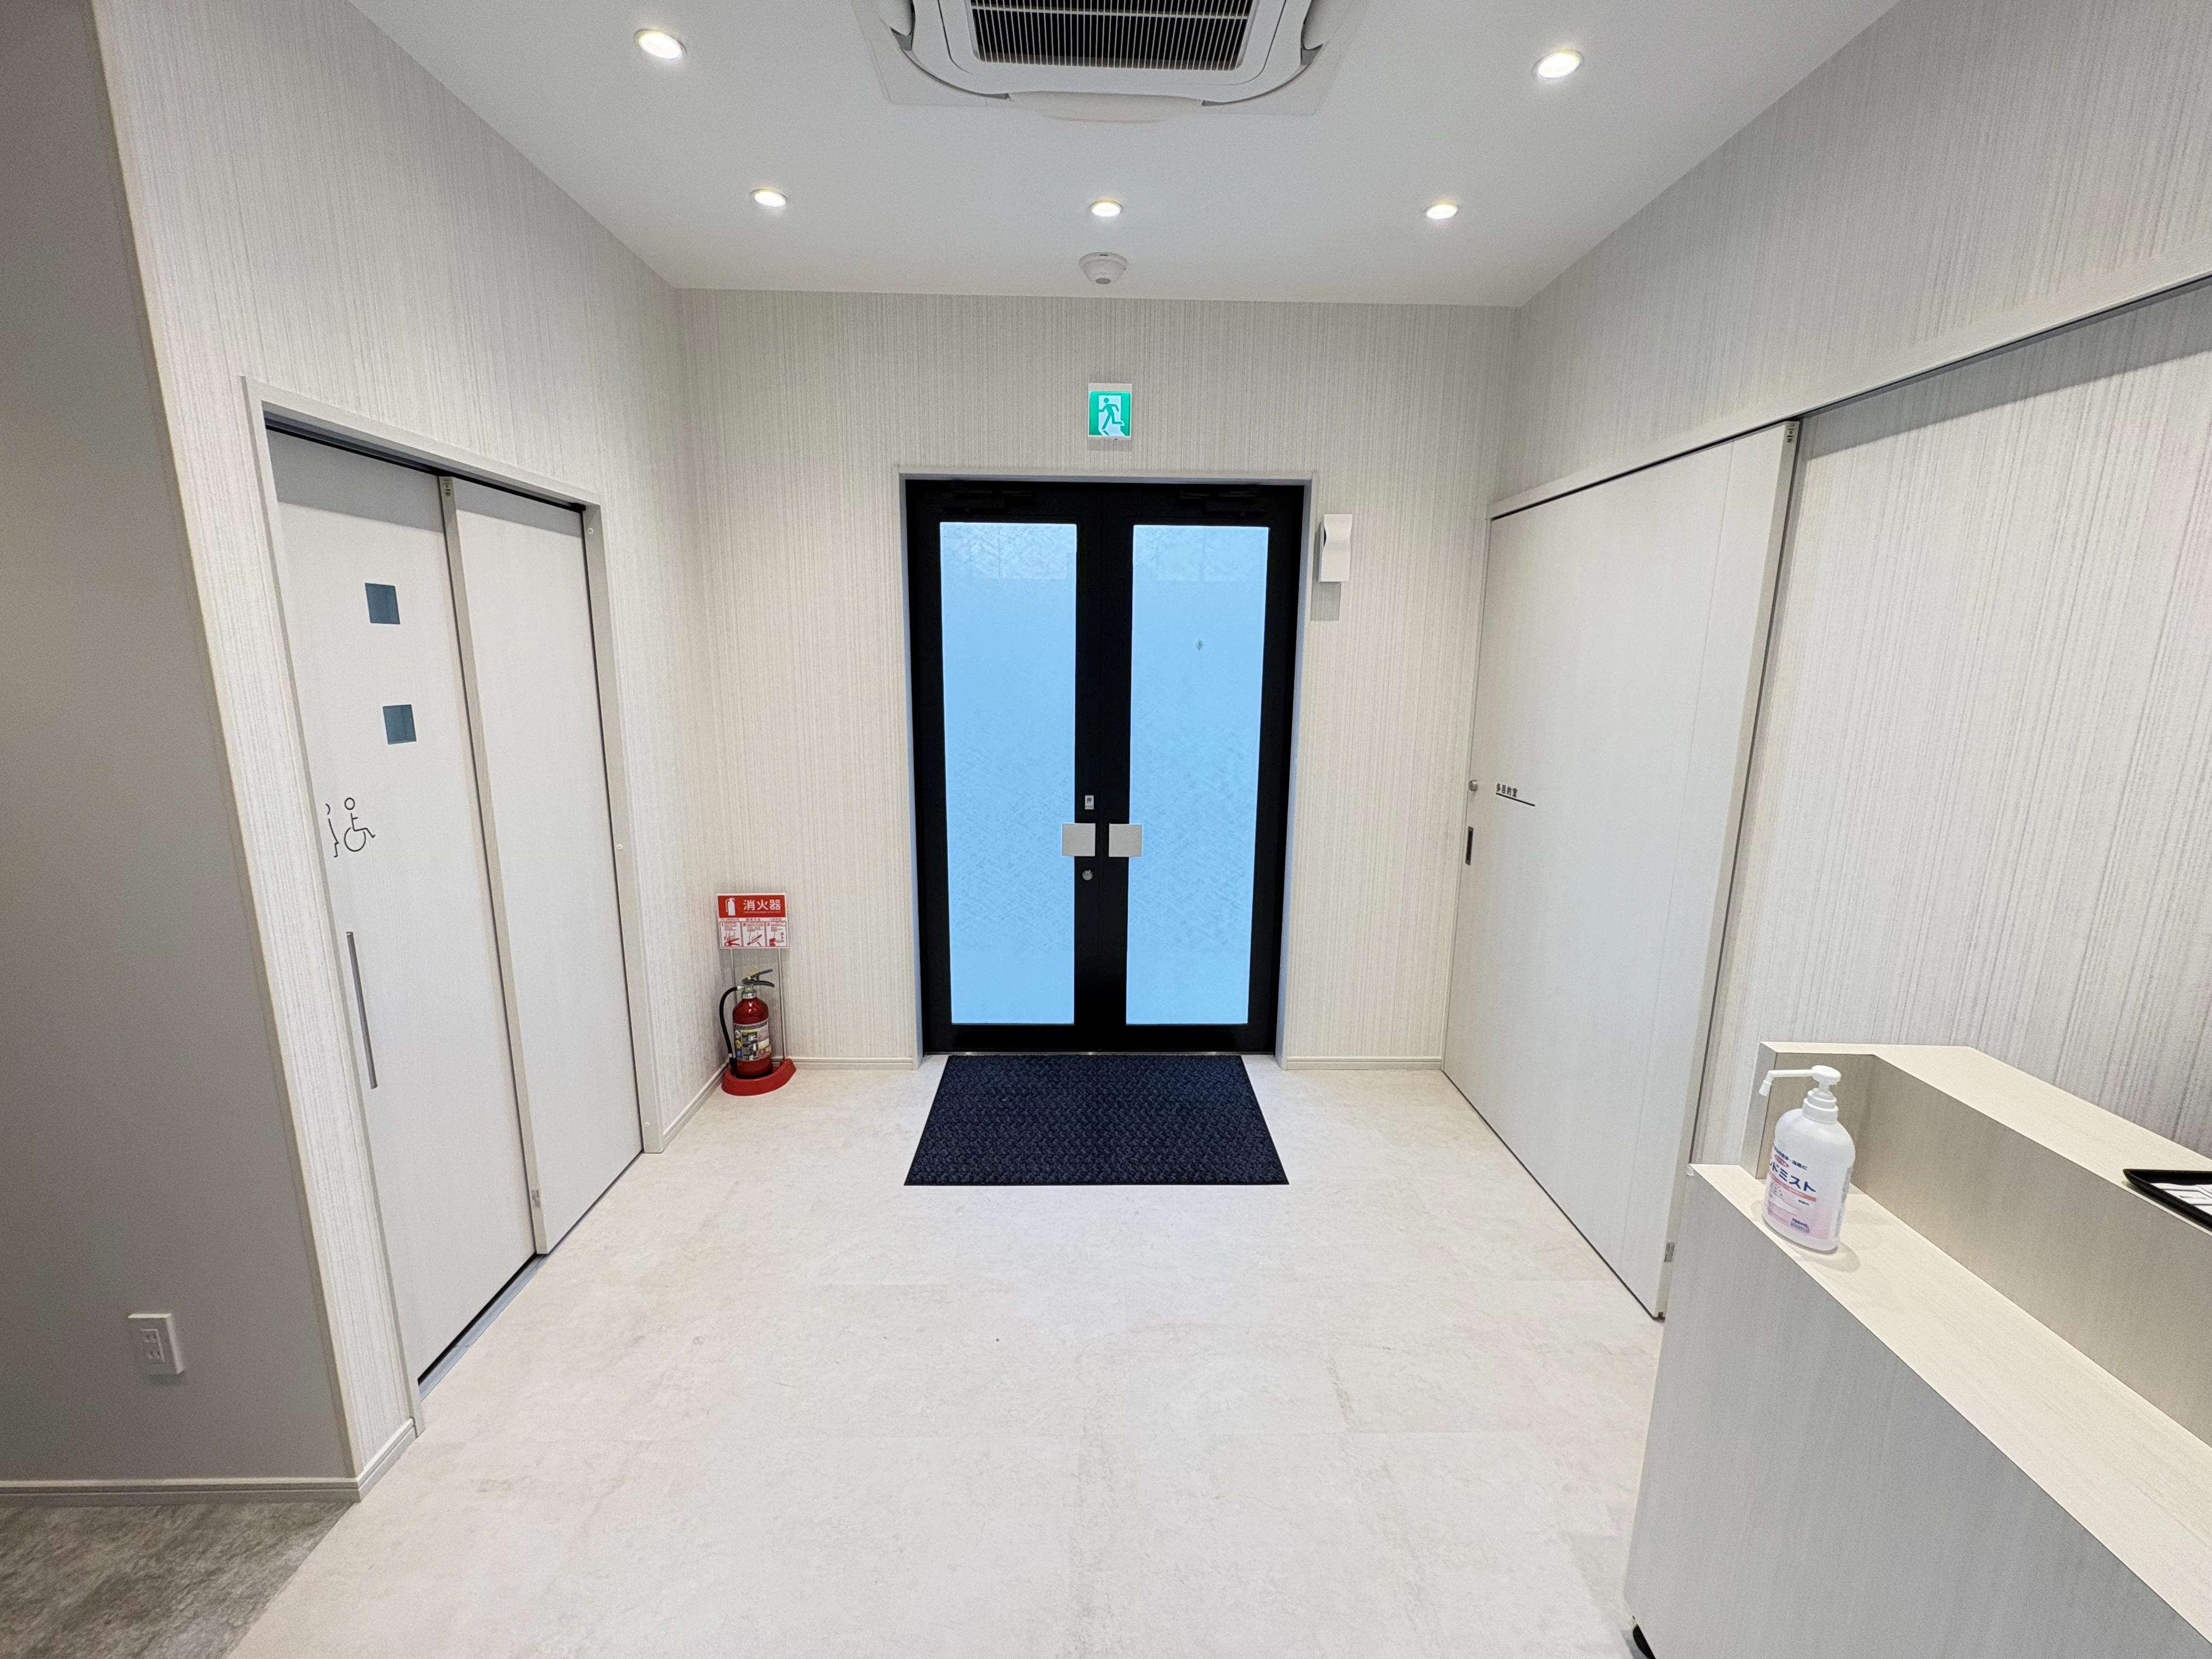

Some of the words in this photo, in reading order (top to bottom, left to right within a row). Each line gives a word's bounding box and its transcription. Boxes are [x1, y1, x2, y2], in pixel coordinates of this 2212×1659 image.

[1496, 783, 1517, 798] 多目的室
[743, 899, 781, 911] 消火器
